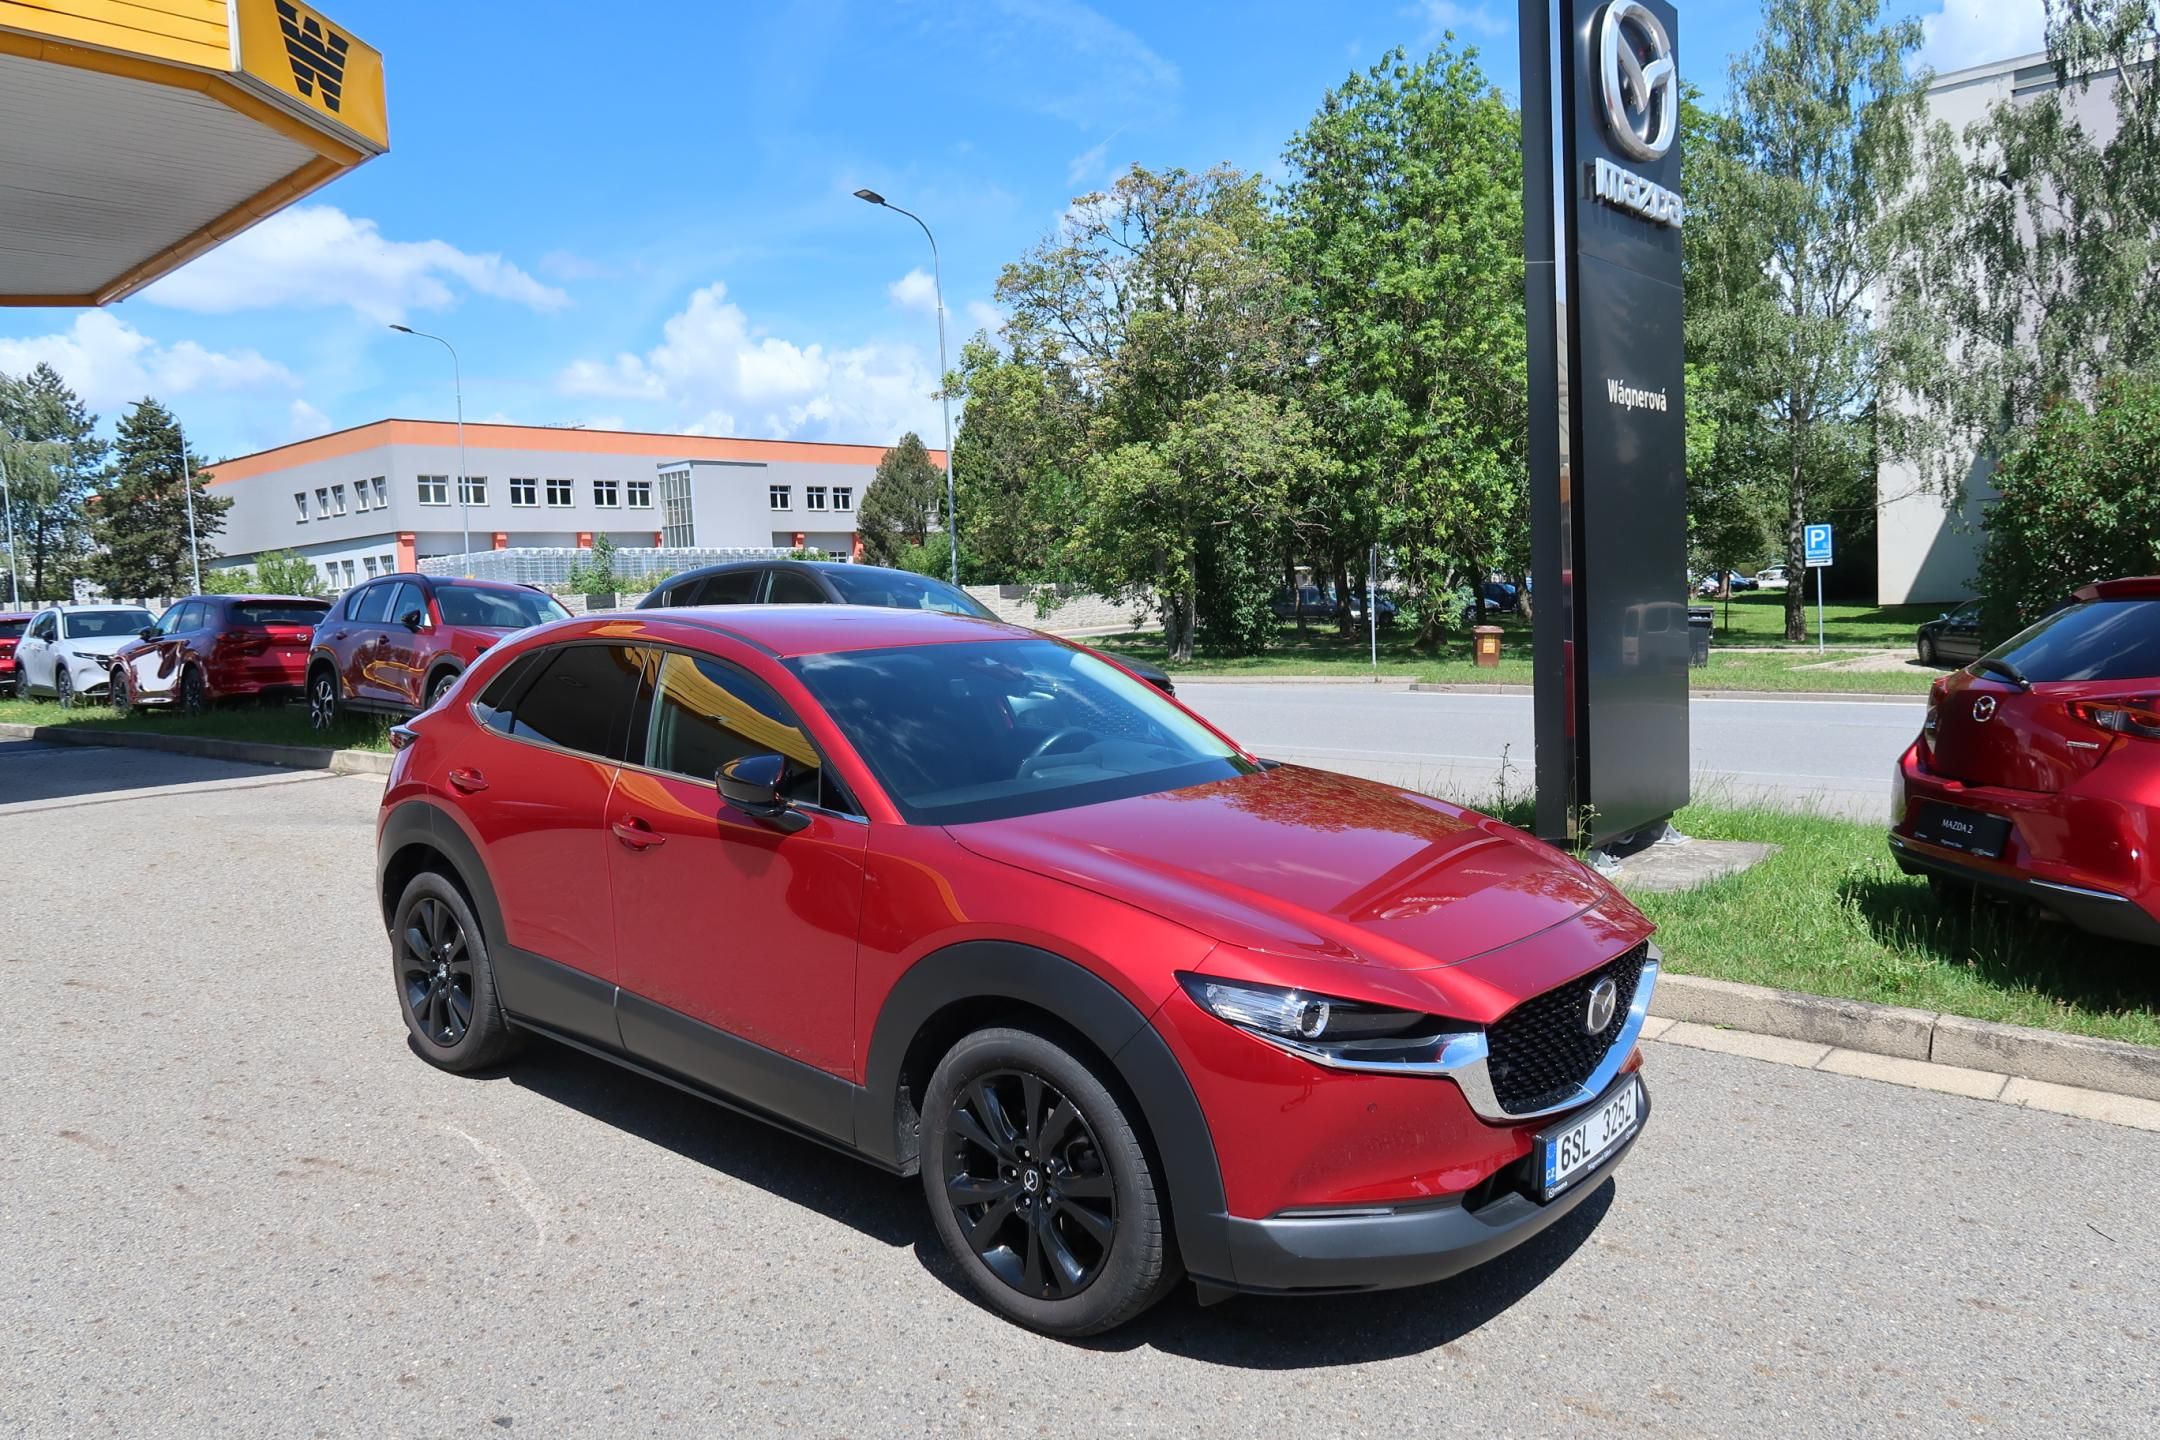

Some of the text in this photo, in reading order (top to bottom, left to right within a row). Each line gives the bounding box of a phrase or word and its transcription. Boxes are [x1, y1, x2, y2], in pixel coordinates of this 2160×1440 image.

[1607, 378, 1667, 412] Wágnerová
[1811, 529, 1826, 549] P
[1942, 819, 1974, 834] MAZDA 2
[1561, 1124, 1591, 1171] 6SL
[1602, 1088, 1632, 1142] 3252
[1546, 1166, 1556, 1181] CZ
